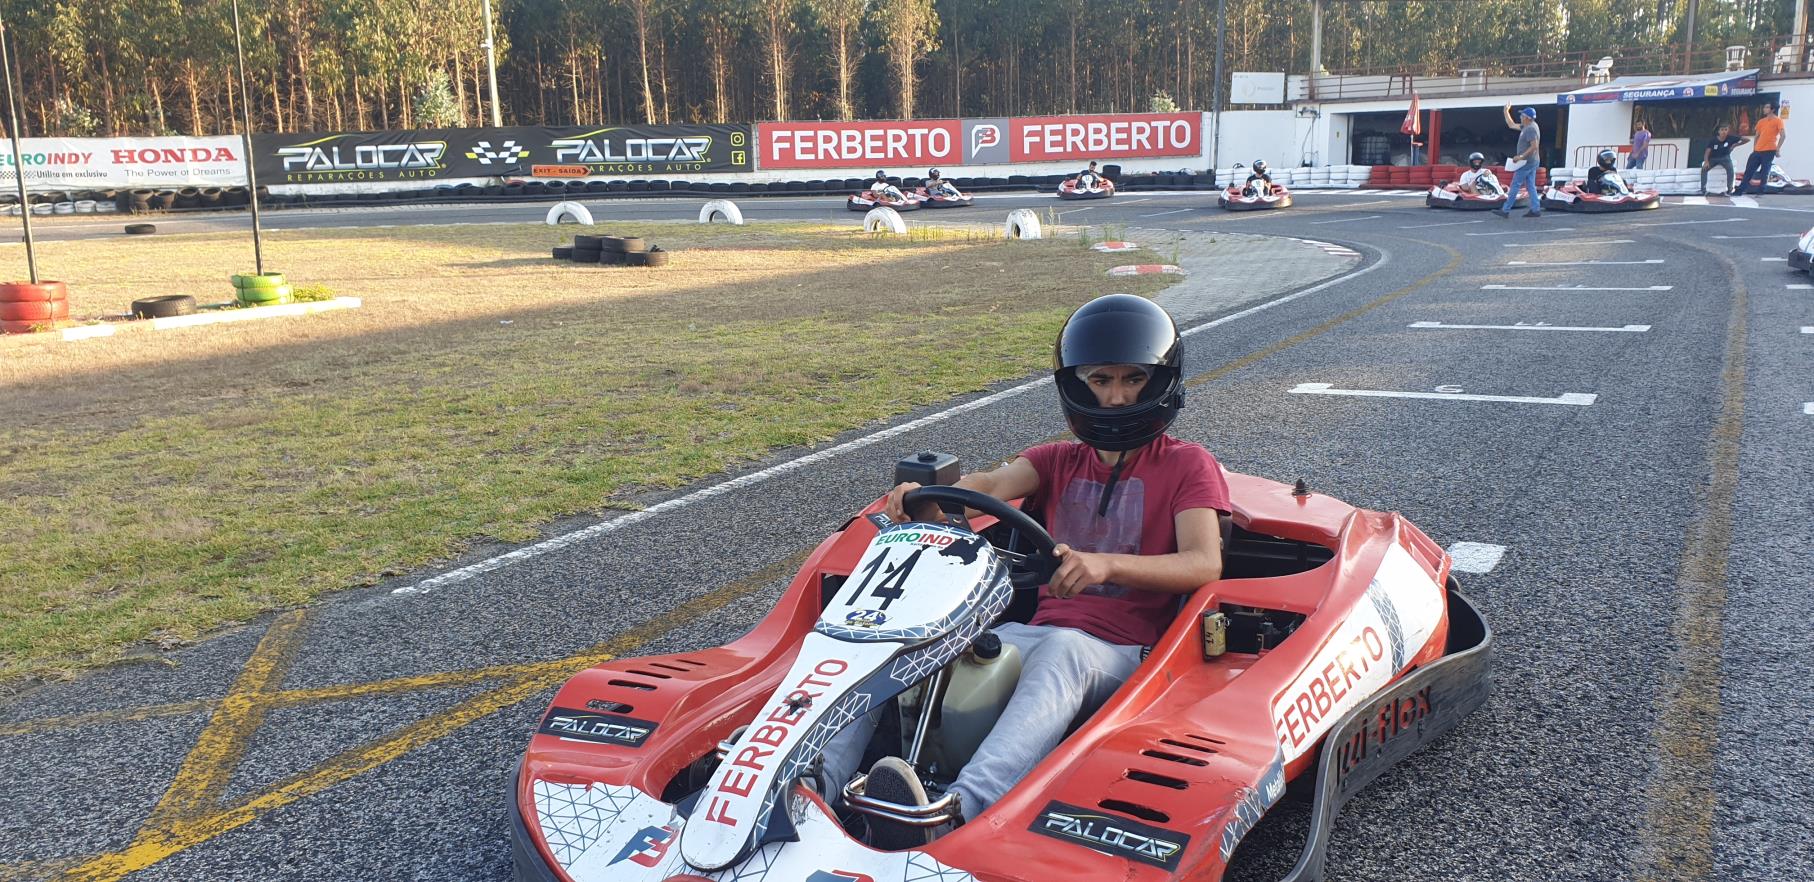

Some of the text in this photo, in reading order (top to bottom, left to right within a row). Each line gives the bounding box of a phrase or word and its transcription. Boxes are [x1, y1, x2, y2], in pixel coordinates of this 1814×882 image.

[1623, 89, 1675, 98] SEGURANÇA
[772, 127, 951, 161] FERBERTO
[1023, 119, 1192, 155] FERBERTO
[110, 147, 238, 164] HONDA
[277, 136, 712, 171] PALOCAR PALOCAR
[124, 169, 144, 177] The
[147, 169, 177, 177] Power
[193, 168, 231, 176] Dreams
[287, 169, 436, 182] REPARAÇÕES AUTO
[589, 163, 702, 173] ARAÇÕES AUTO
[875, 532, 954, 546] EUROIND
[845, 547, 923, 611] 14
[550, 715, 650, 744] PALOCAR
[705, 658, 849, 828] FERBERTO
[1044, 811, 1182, 863] PALOCAR
